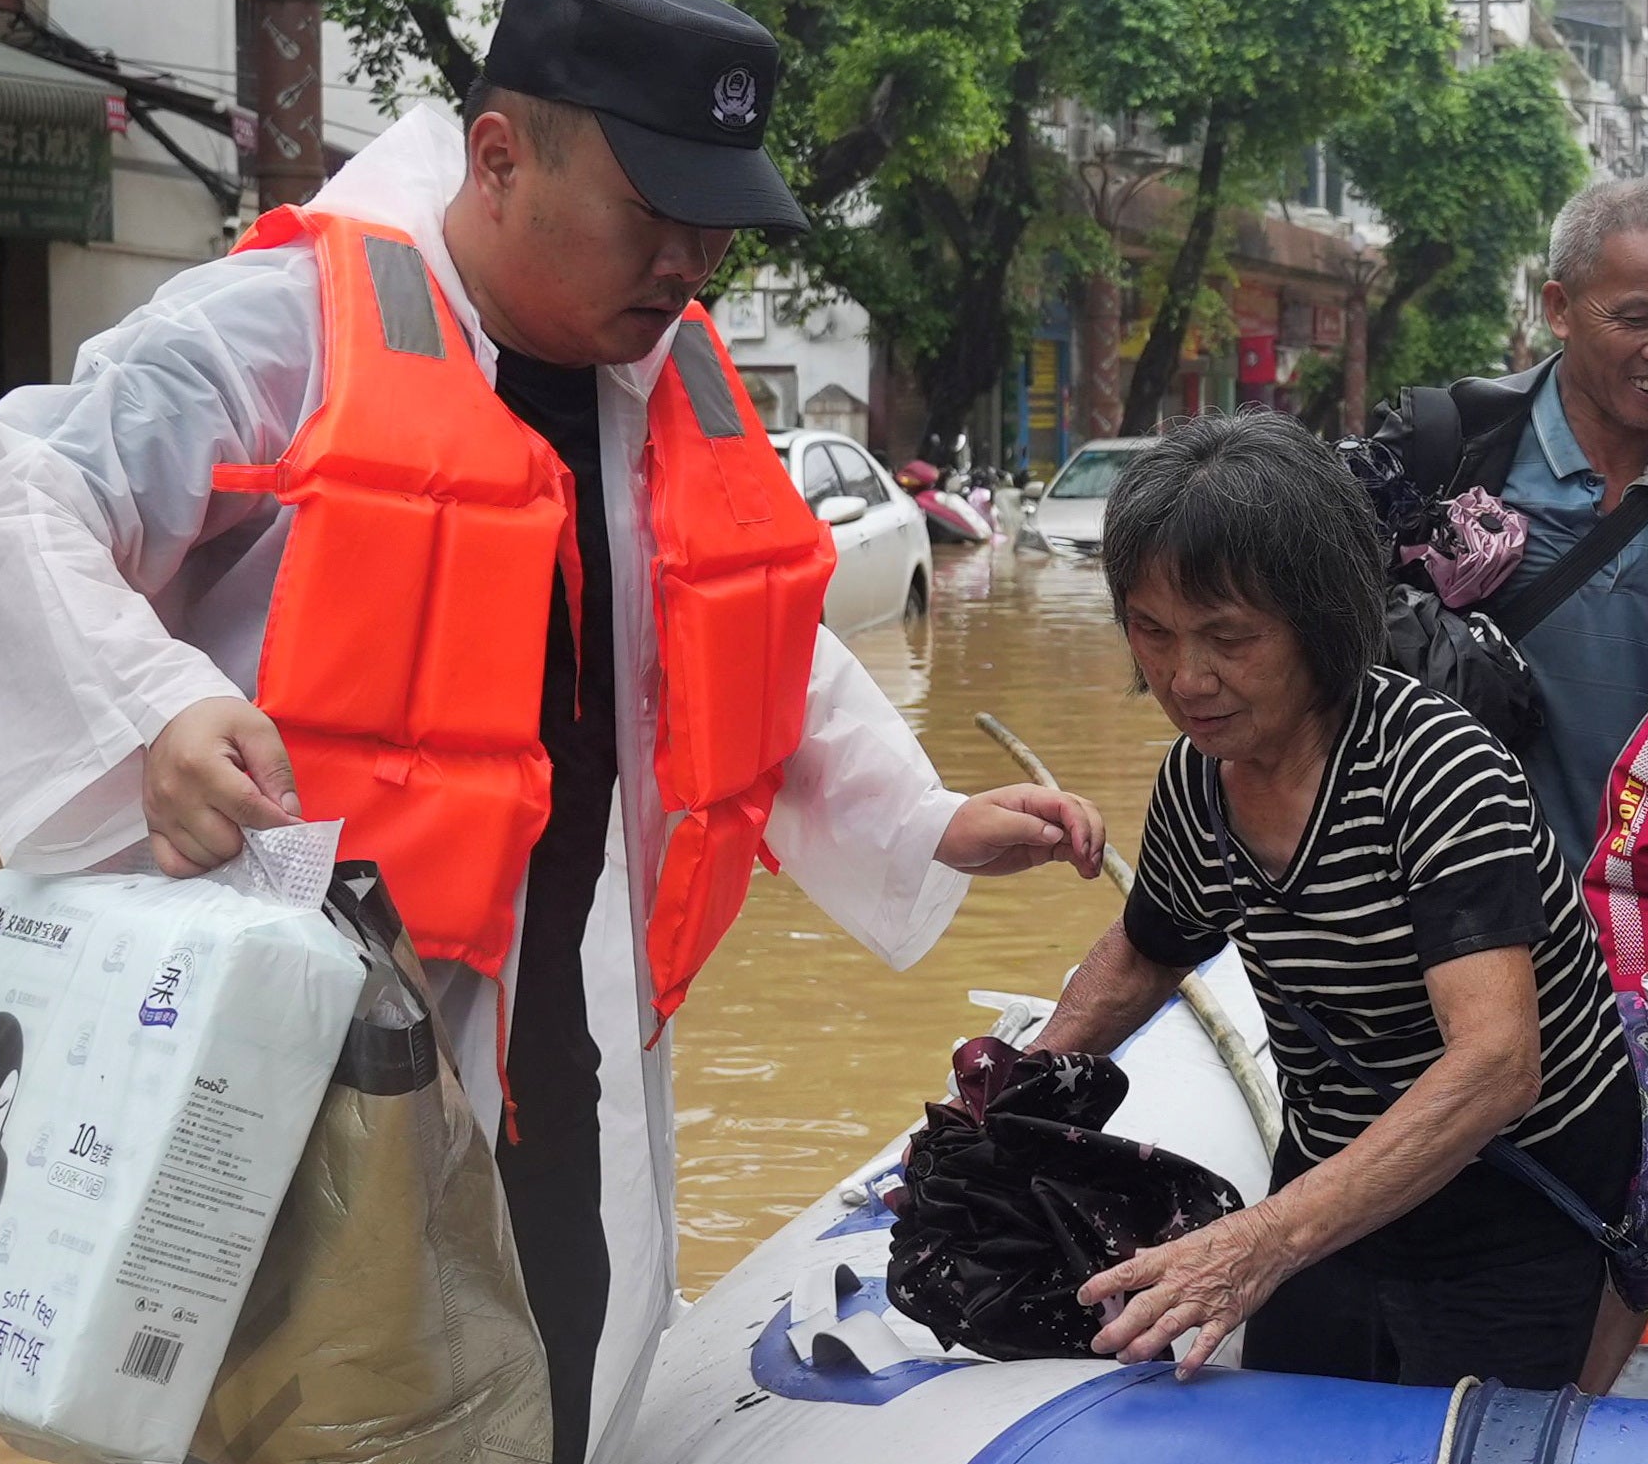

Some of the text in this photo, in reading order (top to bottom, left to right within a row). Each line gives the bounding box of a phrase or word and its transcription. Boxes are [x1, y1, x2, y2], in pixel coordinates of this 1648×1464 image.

[1611, 776, 1644, 852] SPORT
[148, 967, 182, 1004] 柔
[2, 1288, 57, 1327] soft feel
